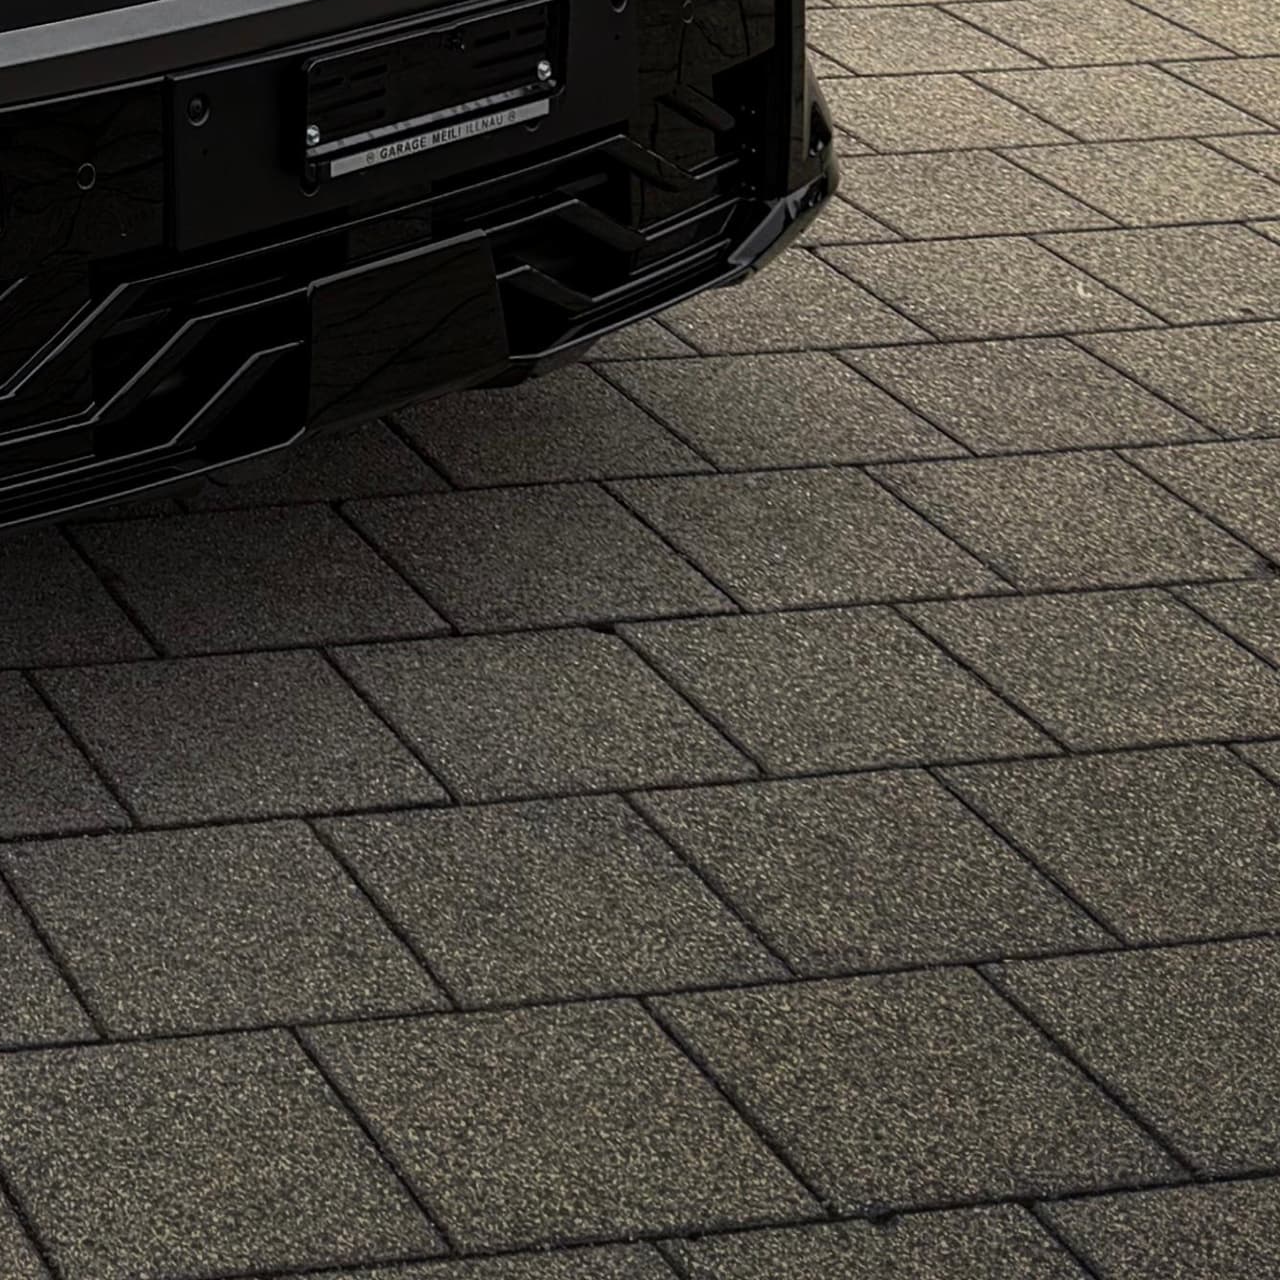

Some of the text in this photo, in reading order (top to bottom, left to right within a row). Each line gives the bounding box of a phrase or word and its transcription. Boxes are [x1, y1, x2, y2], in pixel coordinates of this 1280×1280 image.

[379, 114, 505, 159] GARAGE MEILI ILLNAU
